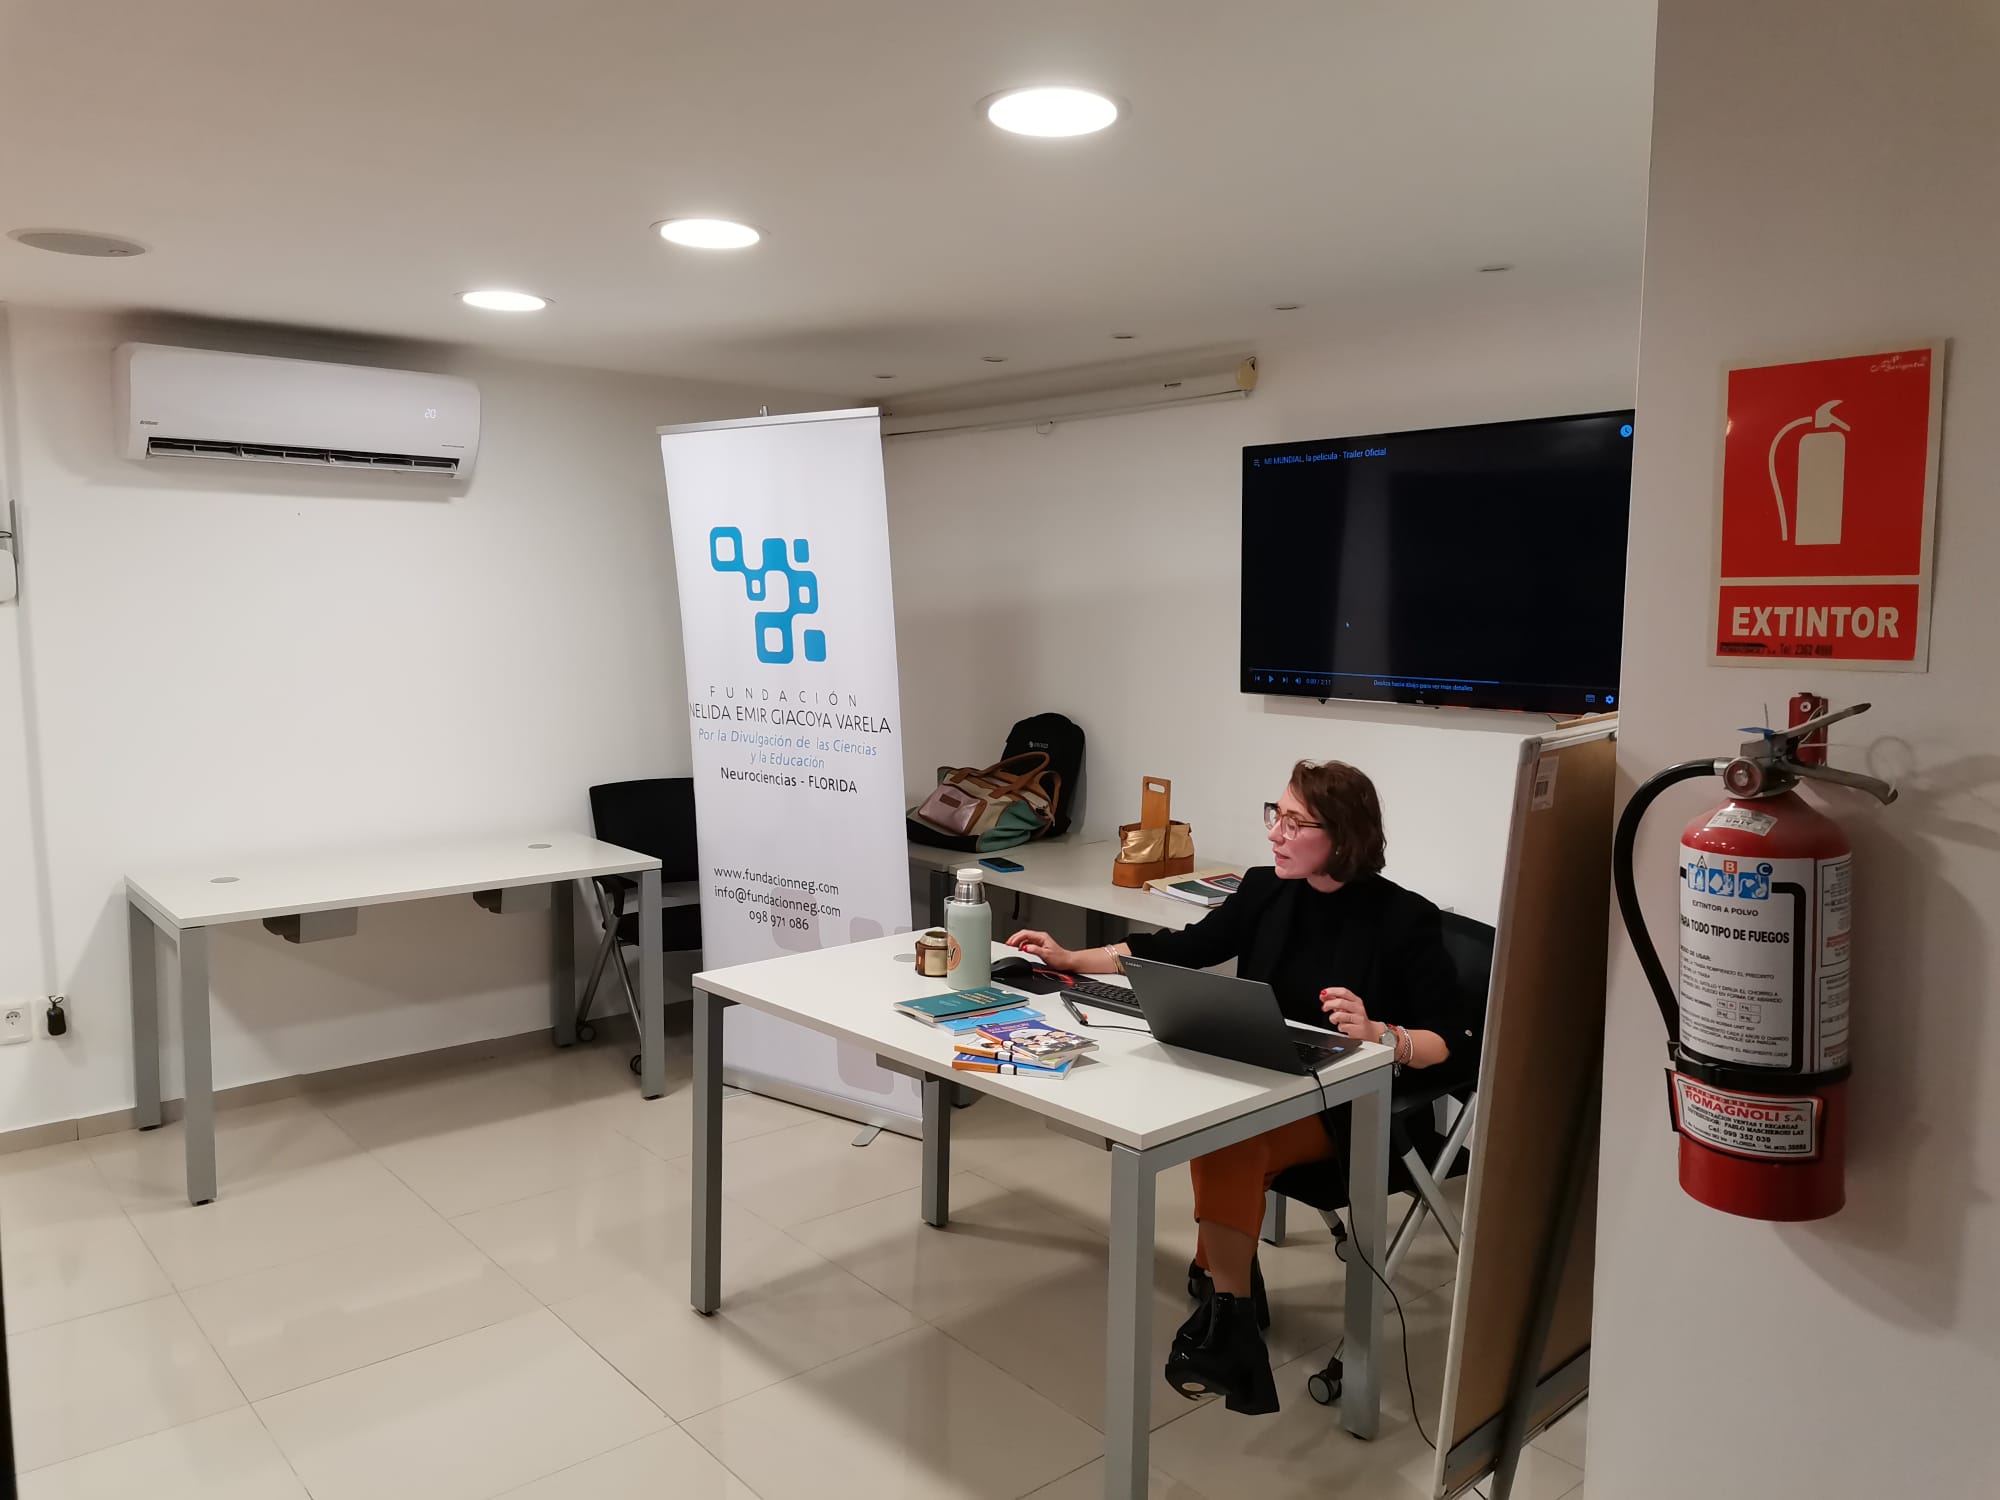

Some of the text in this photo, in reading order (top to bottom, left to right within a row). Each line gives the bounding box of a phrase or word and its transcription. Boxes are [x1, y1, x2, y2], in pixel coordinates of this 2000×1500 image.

[1732, 606, 1899, 638] EXTINTOR
[709, 686, 857, 707] FUNDACIÓN
[690, 703, 891, 733] NELIDA EMIR GIACOYA VARELA
[699, 728, 877, 756] Por la Divulgación de las Ciencias
[750, 750, 825, 768] y la Educación
[720, 767, 797, 787] Neurociencias
[808, 775, 858, 793] FLORIDA
[713, 867, 839, 896] www.fundacionneg.com
[1725, 861, 1735, 873] B
[1759, 864, 1769, 876] C
[714, 885, 841, 918] info@fundacionneg.com
[1692, 900, 1722, 912] EXTINTOR
[1731, 908, 1759, 917] POLVO
[749, 910, 809, 931] 098 971 086
[1691, 919, 1710, 934] TODO
[1710, 924, 1731, 939] TIPO
[1733, 929, 1747, 941] DE
[1748, 931, 1790, 944] FUEGOS
[1685, 1090, 1779, 1122] ROMAGNOLI
[1784, 1114, 1807, 1122] S.A.
